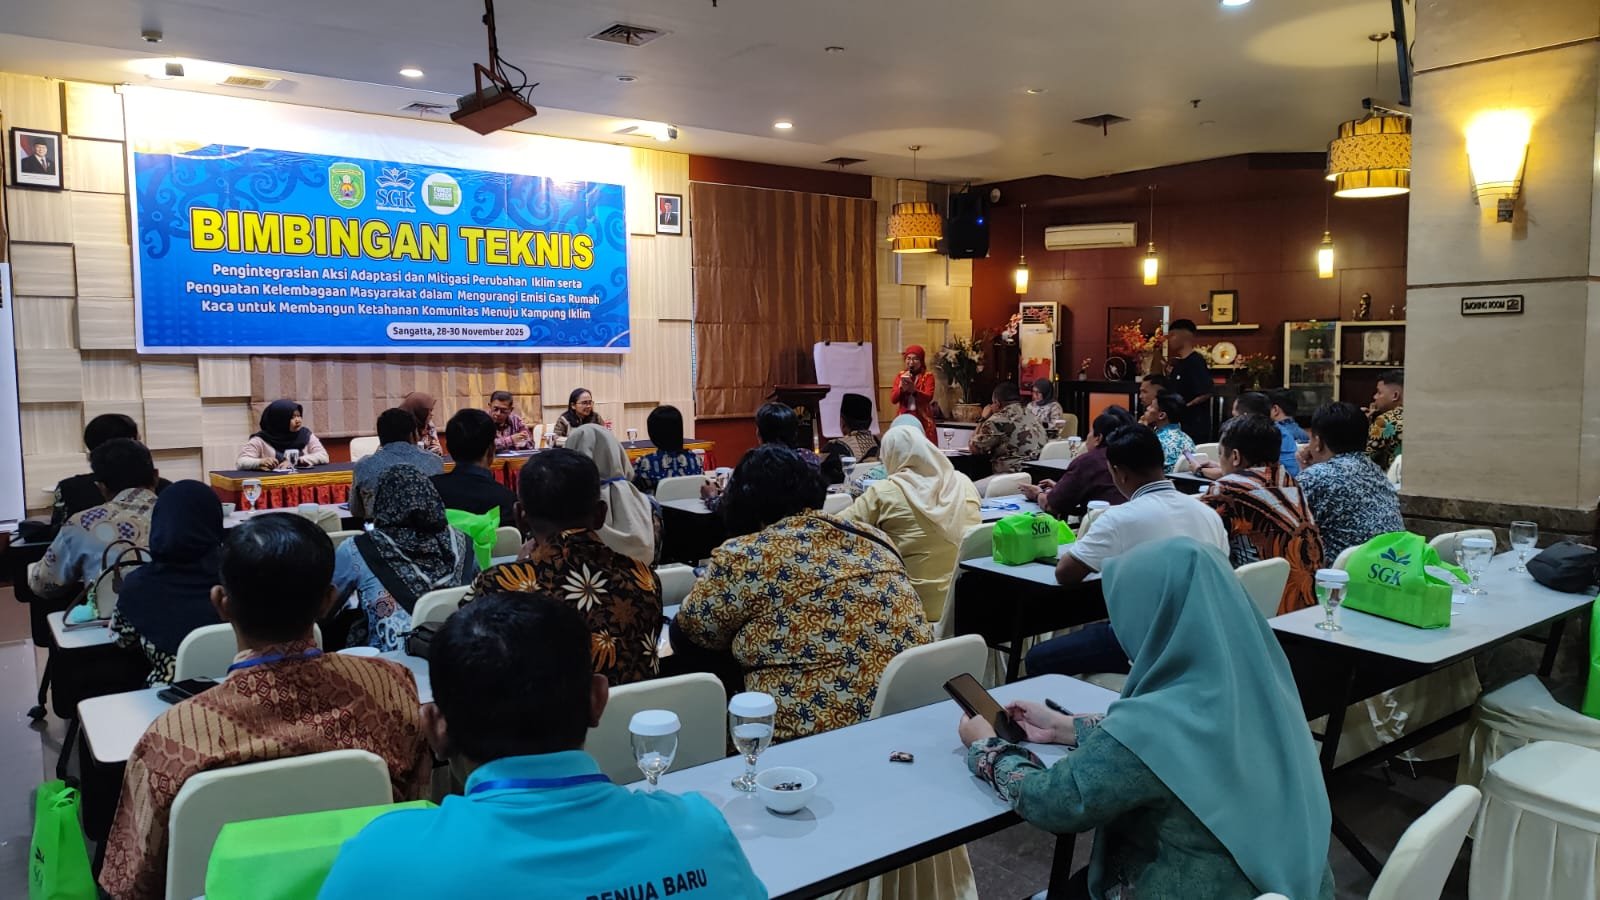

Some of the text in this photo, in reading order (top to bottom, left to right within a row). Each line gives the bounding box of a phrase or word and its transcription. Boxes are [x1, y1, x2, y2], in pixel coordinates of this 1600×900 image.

[375, 189, 416, 207] SGK
[190, 207, 595, 271] BIMBINGAN TEKNIS
[212, 263, 583, 289] Pengintegrasian Aksi Adaptasi dan Mitigasi Perubahan Iklim serta
[186, 281, 600, 305] Penguatan Kelembagaan Masyarakat dalam Mengurangi Emisi Gas Rumah
[202, 300, 591, 321] Kaca untuk Membangun Ketahanan Komunitas Menuju Kampung Iklim
[393, 326, 524, 337] Sangatta, 28-30 November 2025
[1031, 520, 1051, 536] SGK
[1368, 563, 1407, 586] SGK
[662, 868, 708, 897] BARU
